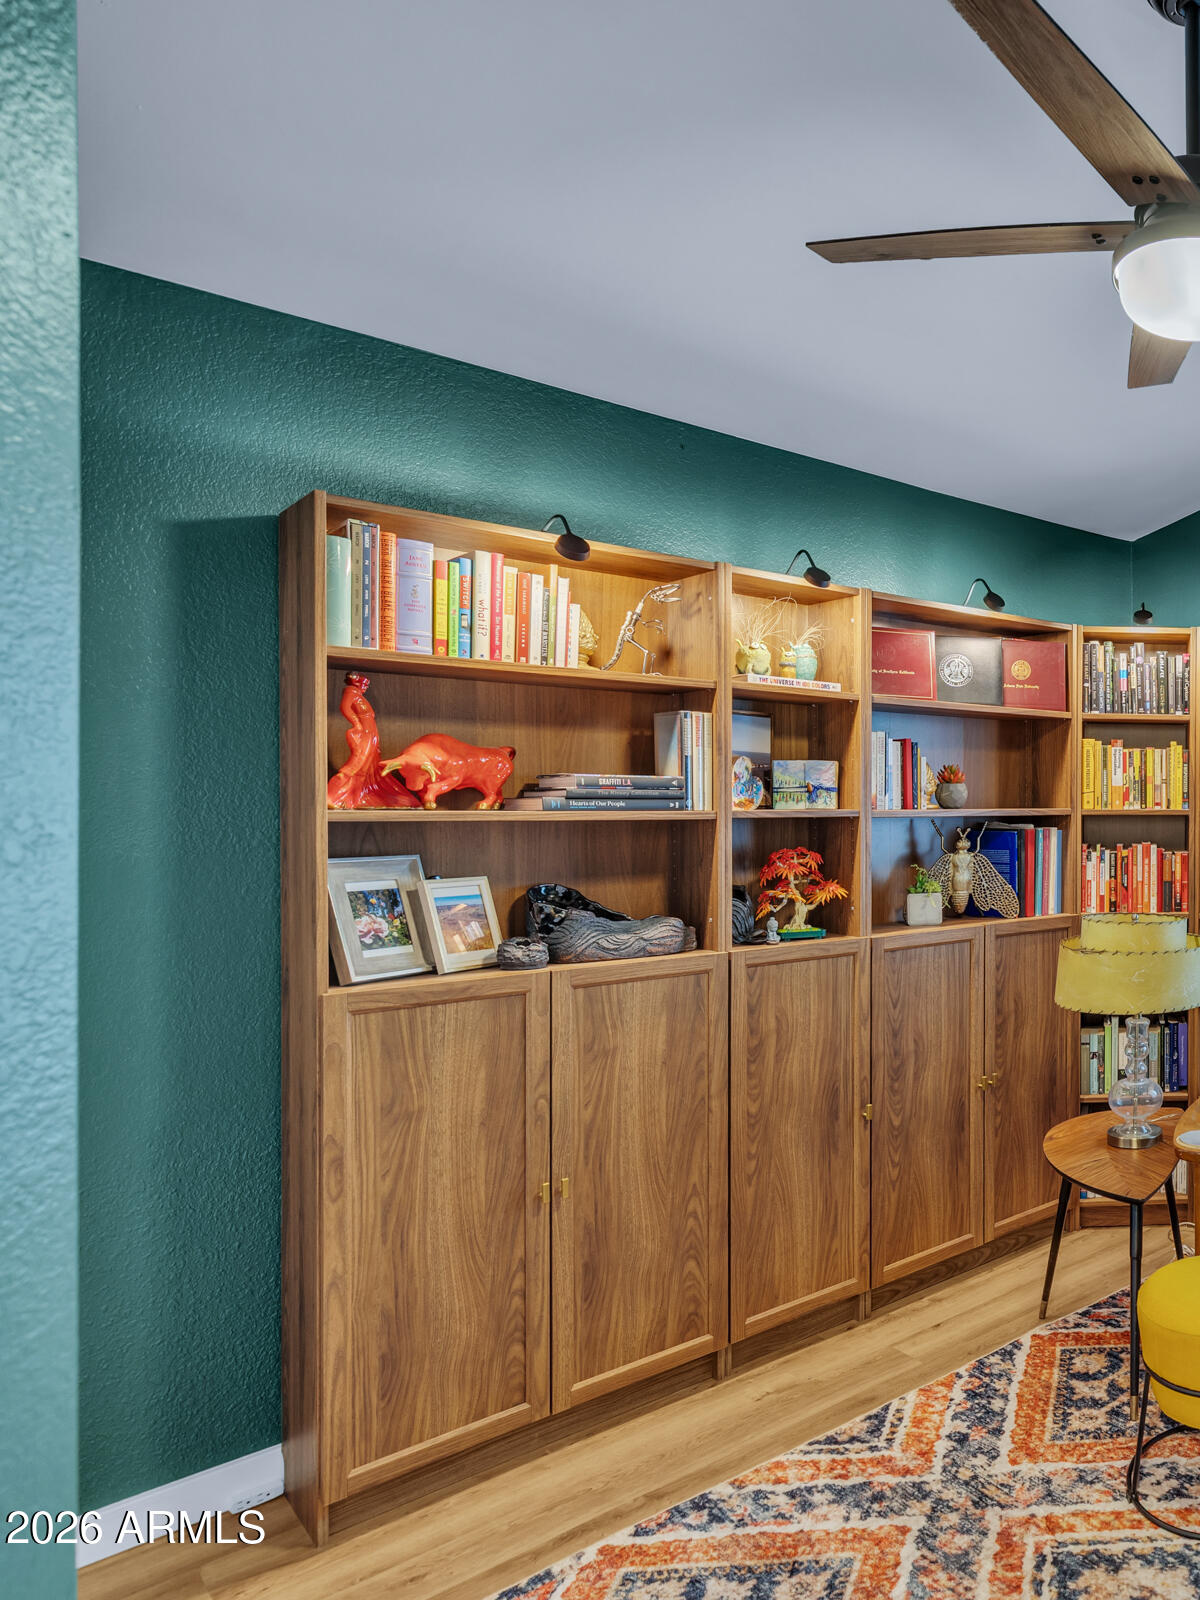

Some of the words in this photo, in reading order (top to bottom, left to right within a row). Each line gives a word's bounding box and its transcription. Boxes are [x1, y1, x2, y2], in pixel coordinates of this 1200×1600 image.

[462, 576, 470, 606] SWITCH
[478, 599, 488, 621] what
[478, 623, 488, 637] if?
[770, 678, 794, 686] UNIVERSE
[811, 682, 831, 690] COLORS
